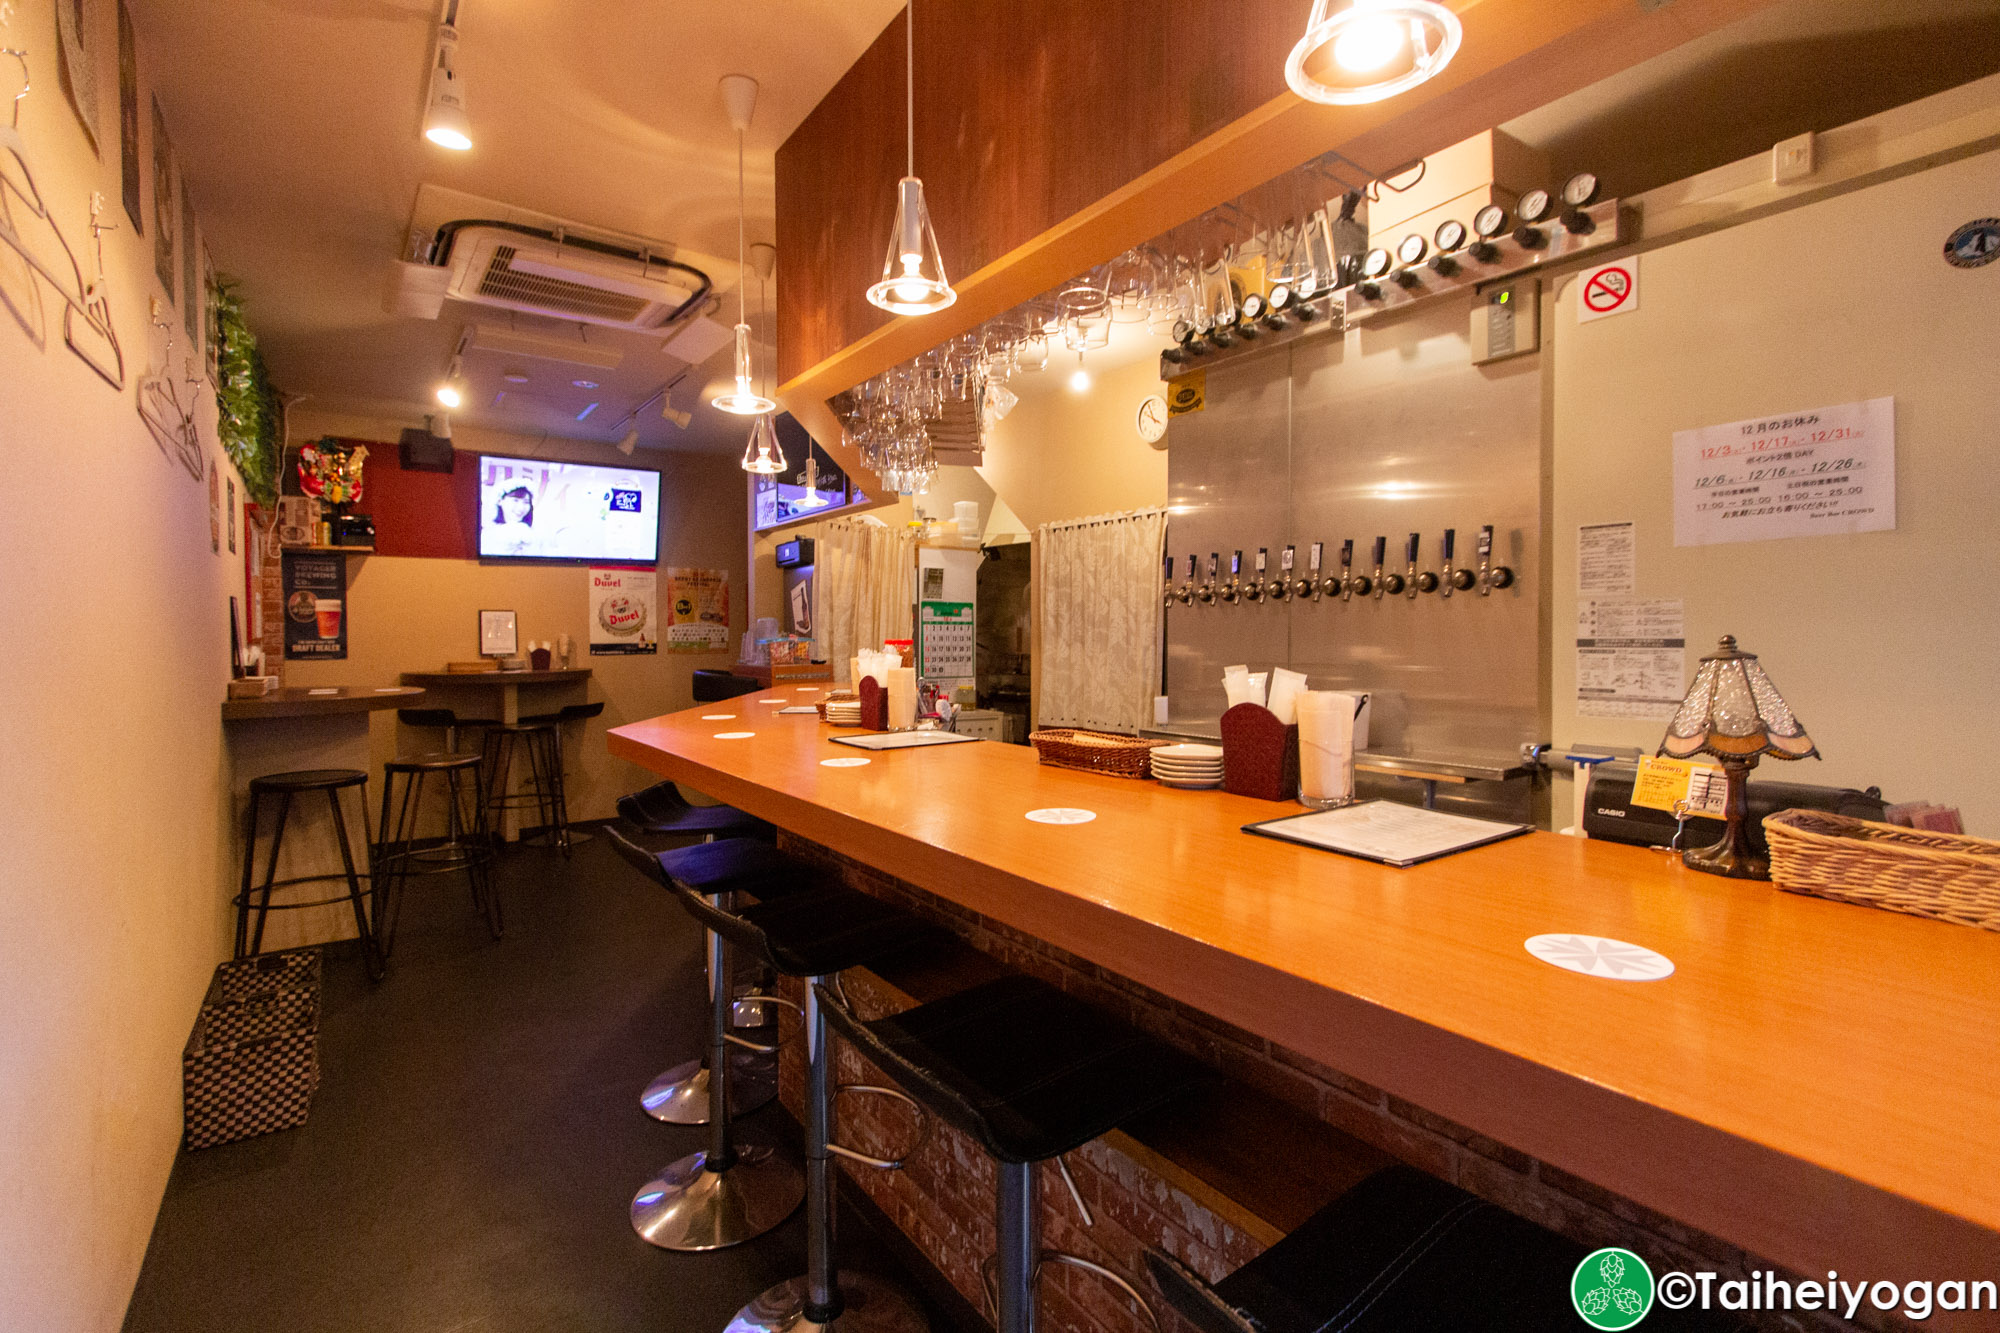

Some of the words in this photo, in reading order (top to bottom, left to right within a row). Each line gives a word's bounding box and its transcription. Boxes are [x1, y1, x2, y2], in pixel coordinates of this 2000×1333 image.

[594, 577, 622, 588] Duvel
[609, 609, 640, 625] Duvel
[1650, 764, 1682, 774] CROWD
[1597, 807, 1626, 818] CASIO
